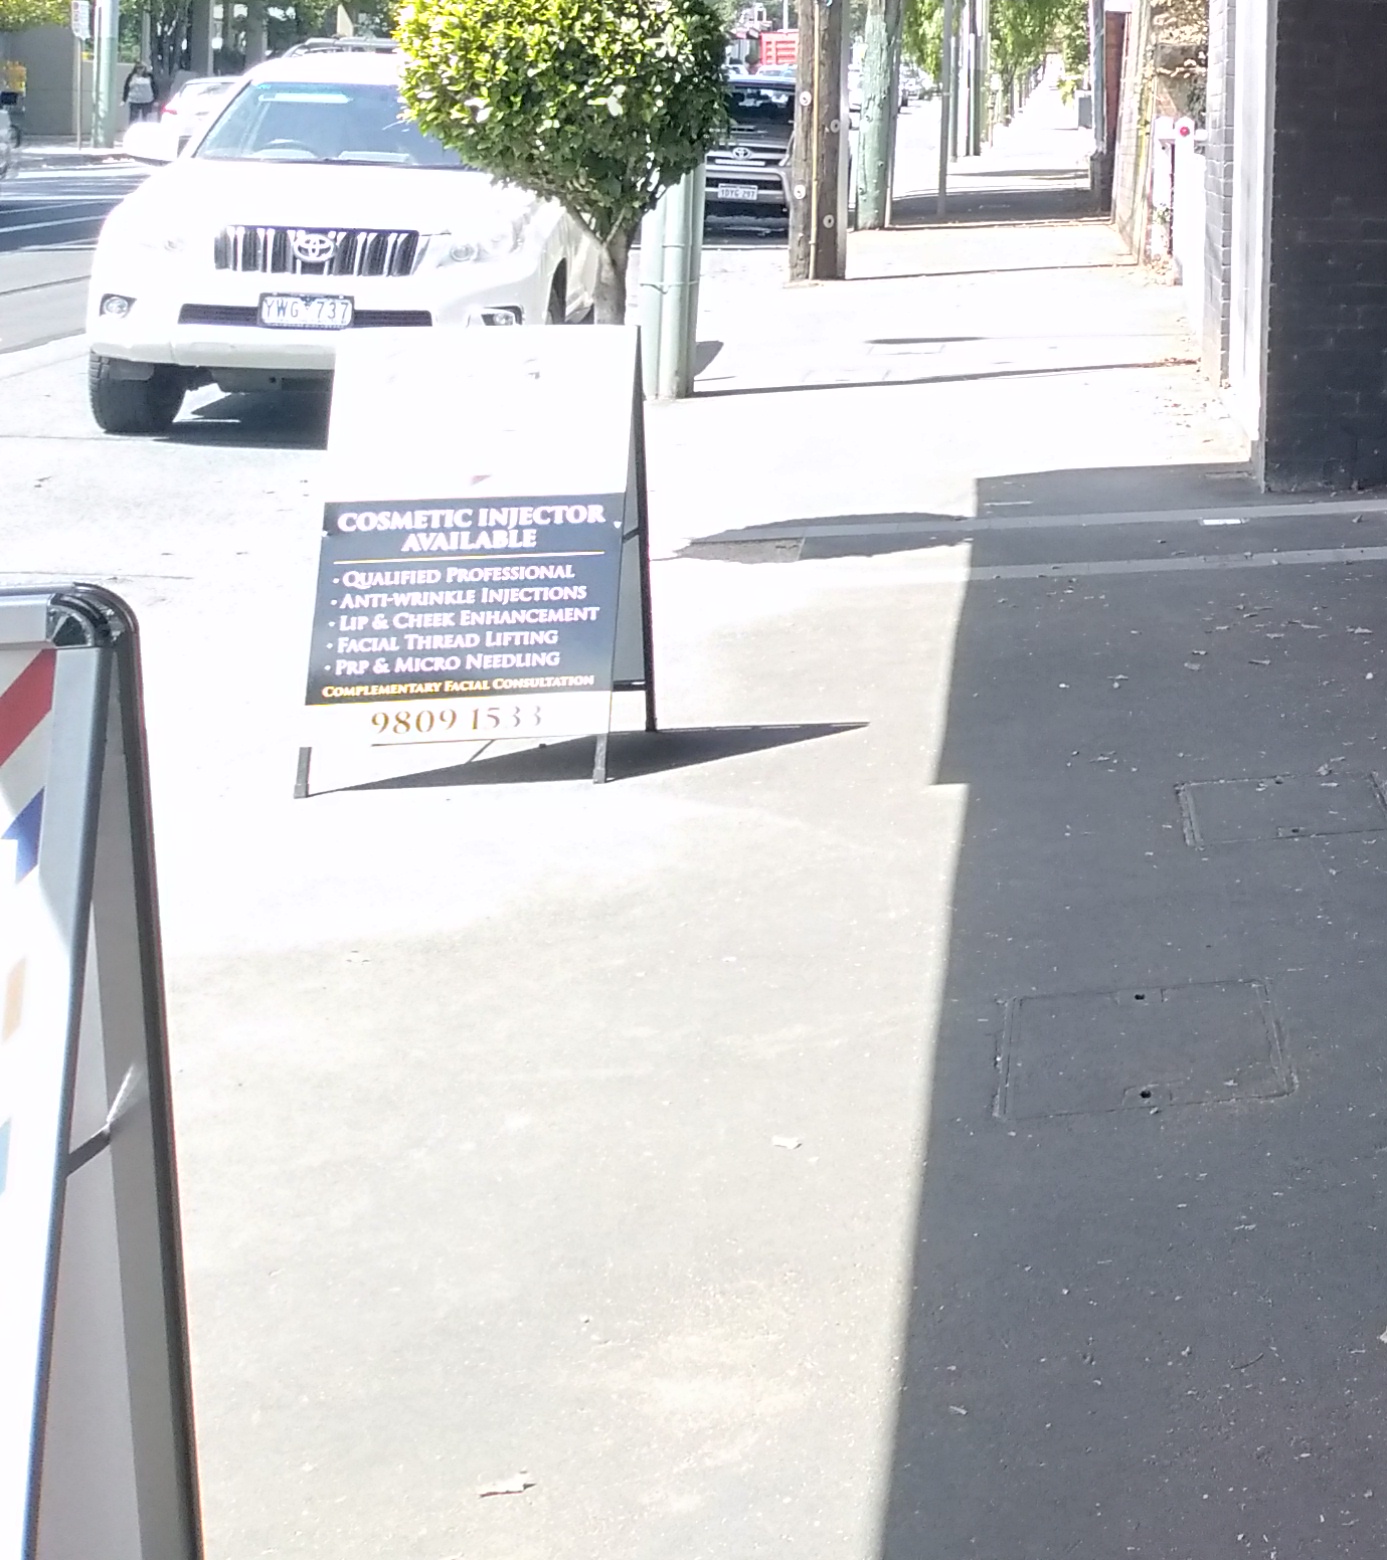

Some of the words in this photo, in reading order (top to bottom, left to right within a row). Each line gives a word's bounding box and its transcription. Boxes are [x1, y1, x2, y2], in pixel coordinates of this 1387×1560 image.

[263, 297, 299, 319] YWG
[316, 301, 350, 321] 737
[338, 508, 473, 532] COSMETIC
[478, 504, 606, 530] INJECTOR
[401, 529, 537, 553] AVAILABLE
[342, 570, 441, 589] QUALIFIED
[446, 565, 576, 585] PROFESSIONAL
[339, 590, 476, 610] ANTI-WRINKLE
[481, 585, 588, 605] INJECTIONS
[339, 615, 370, 631] LIP
[371, 613, 389, 630] &
[392, 611, 456, 629] CHEEK
[459, 606, 601, 627] ENHANCEMENT
[337, 635, 400, 654] FACIAL
[404, 632, 481, 651] THREAD
[485, 630, 559, 648] LIFTING
[335, 659, 370, 676] PRP
[372, 657, 390, 674] &
[393, 655, 461, 673] MICRO
[465, 651, 561, 670] NEEDLING
[371, 707, 457, 734] 9809
[471, 704, 543, 731] 1533
